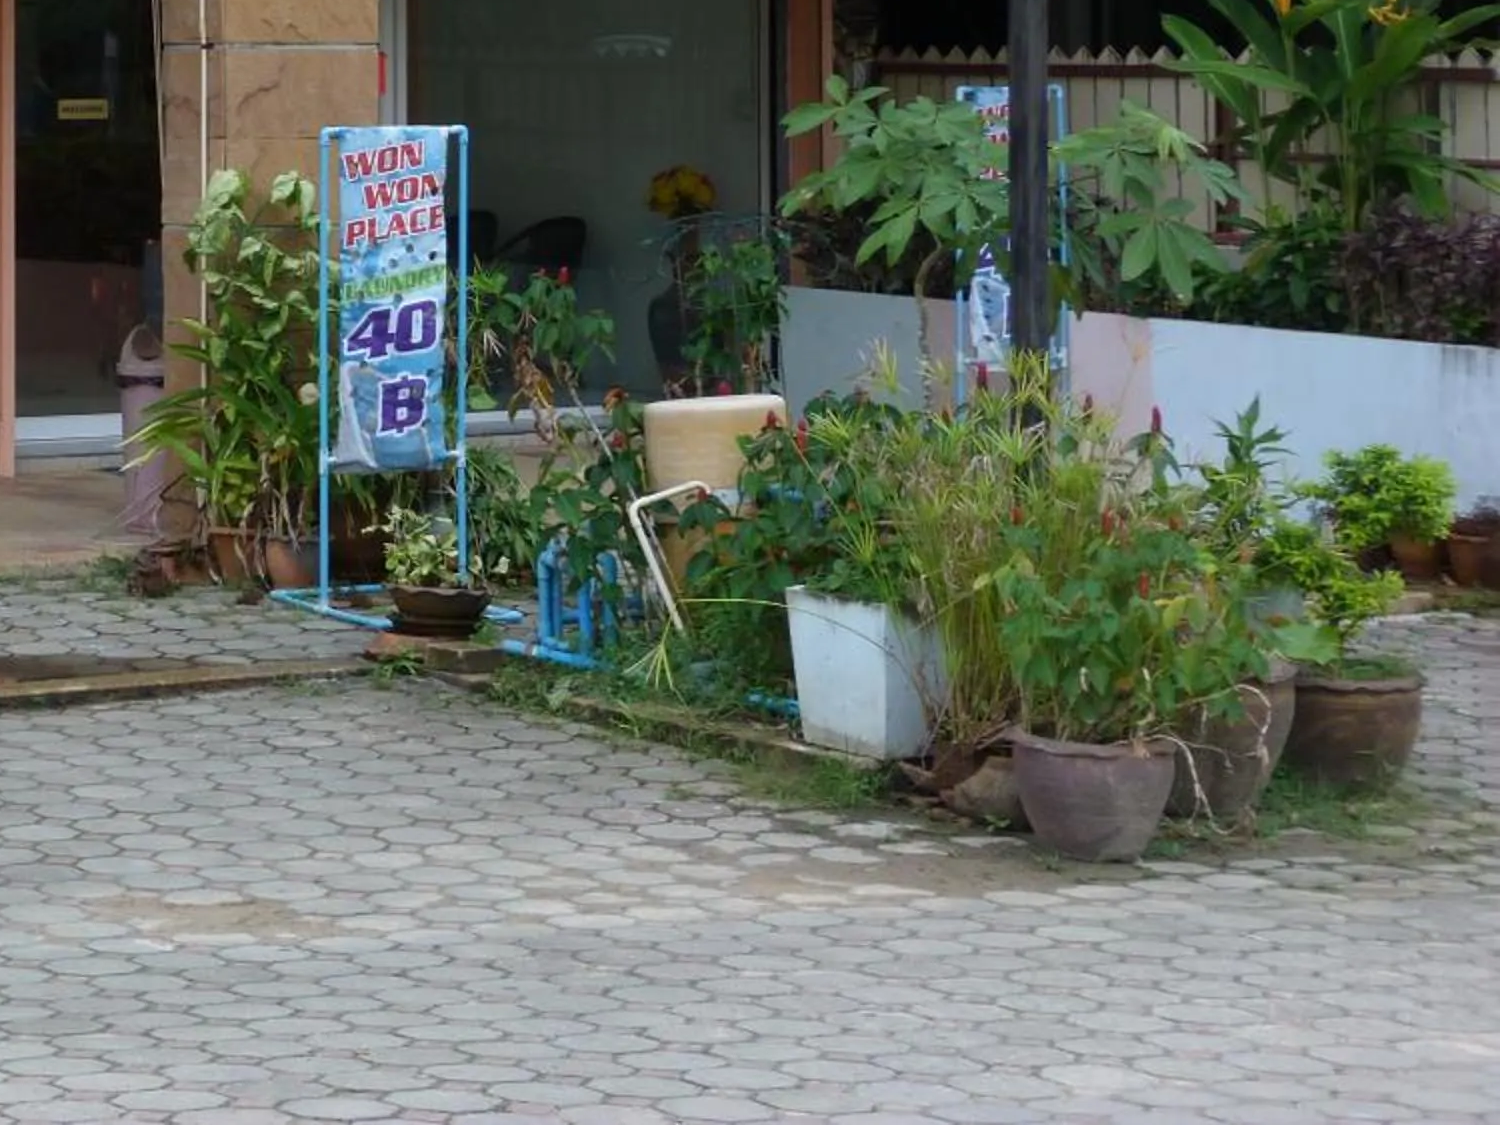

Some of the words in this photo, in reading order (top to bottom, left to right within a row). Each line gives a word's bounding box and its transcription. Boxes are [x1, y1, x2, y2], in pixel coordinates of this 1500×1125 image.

[342, 138, 425, 183] WON
[362, 172, 441, 212] WON
[344, 205, 445, 249] PLACE
[344, 299, 438, 361] 40
